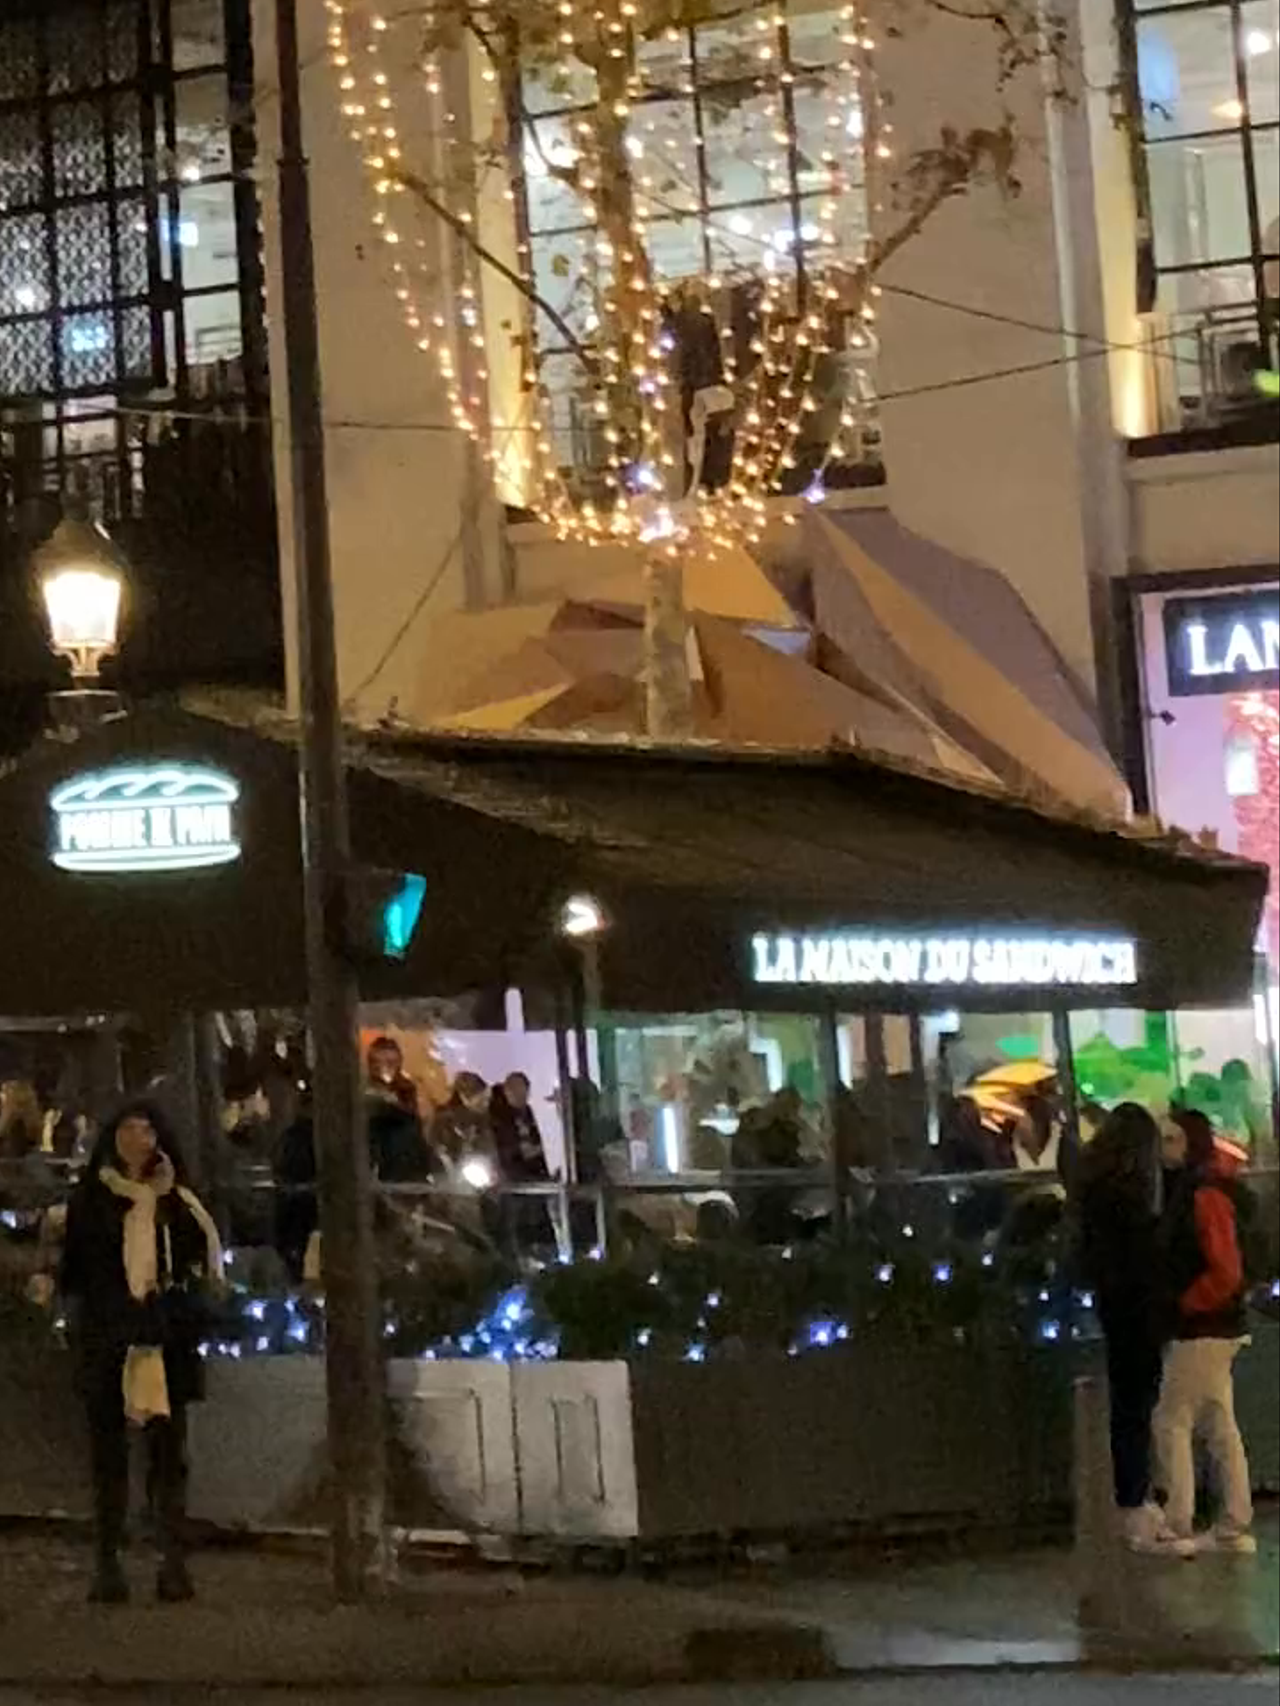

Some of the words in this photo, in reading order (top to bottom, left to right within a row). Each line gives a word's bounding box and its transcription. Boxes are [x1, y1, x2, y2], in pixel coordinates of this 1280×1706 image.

[753, 933, 797, 982] LA
[801, 938, 922, 983] MAISON
[923, 938, 970, 983] DU
[972, 938, 1138, 984] SANDWICH
